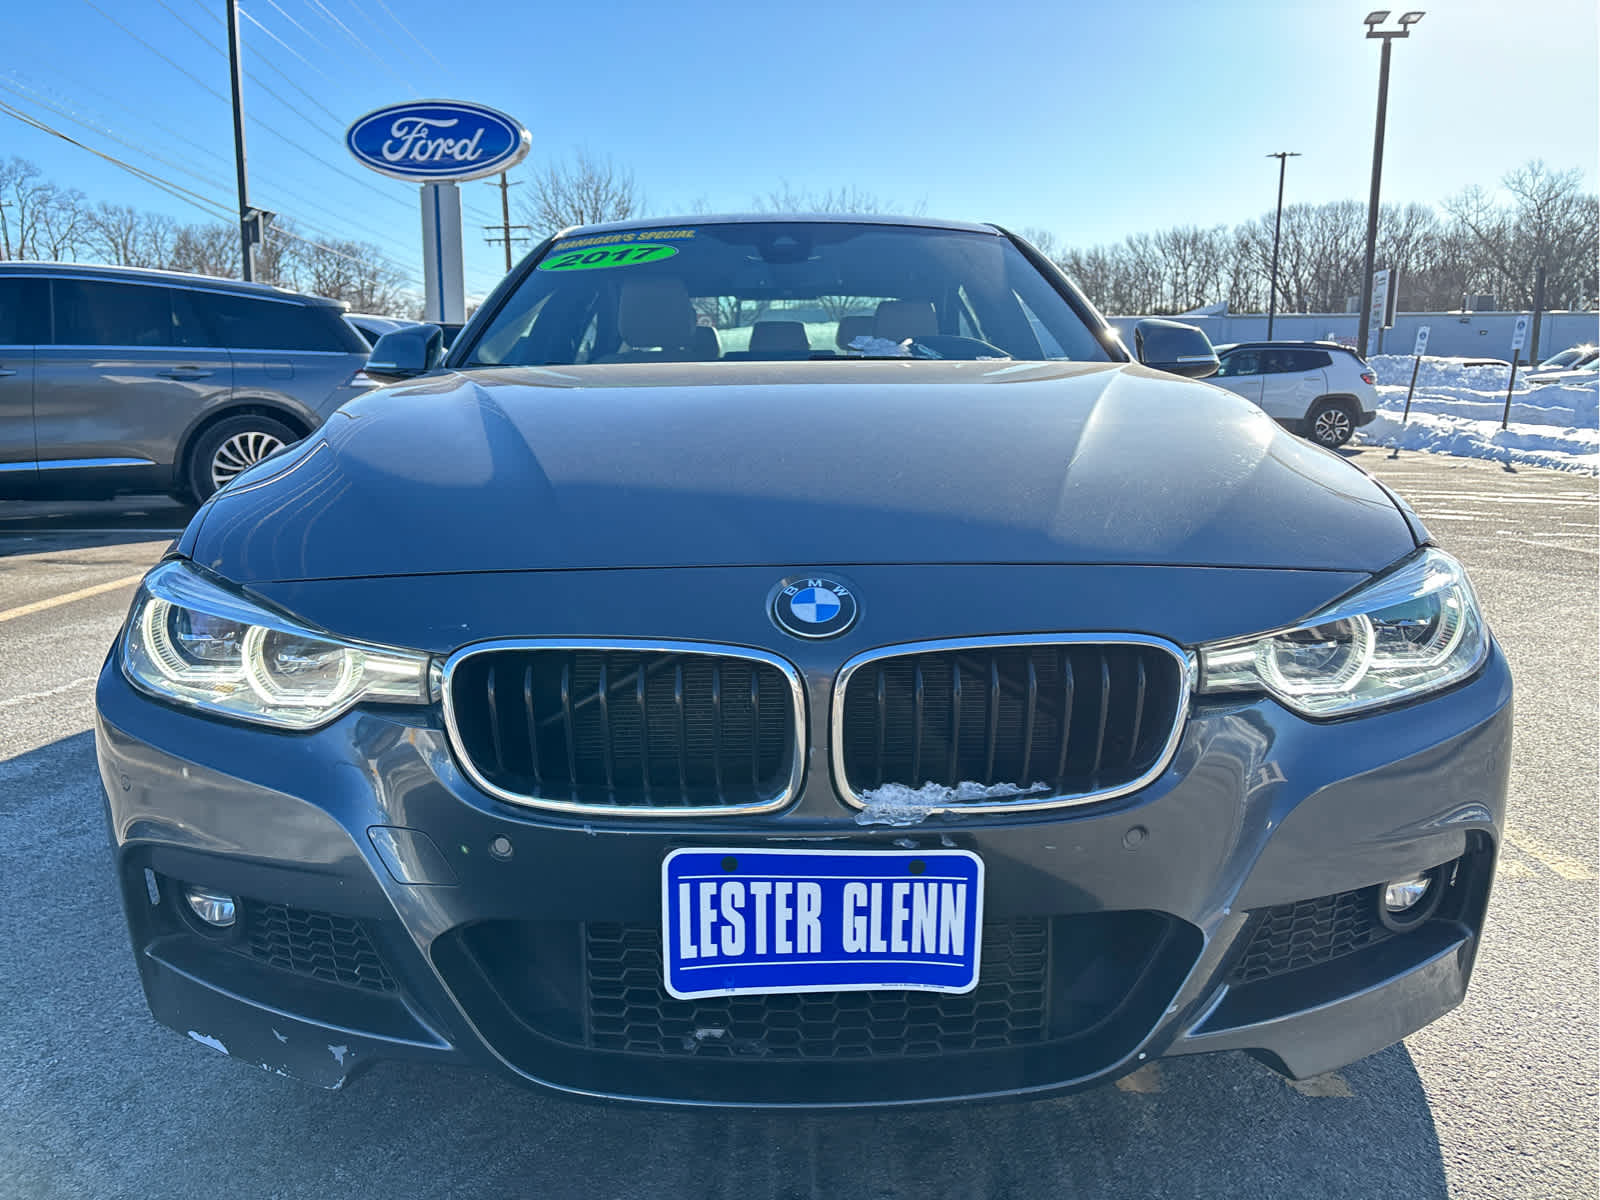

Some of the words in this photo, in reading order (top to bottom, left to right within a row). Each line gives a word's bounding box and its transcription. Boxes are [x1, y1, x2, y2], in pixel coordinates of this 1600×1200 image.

[382, 117, 484, 161] Ford
[554, 233, 636, 250] MANAGER'S
[638, 230, 696, 240] SPECIAL
[552, 247, 664, 269] 2017
[784, 579, 849, 596] BMW
[679, 881, 822, 960] LESTER
[842, 881, 967, 956] GLENN
